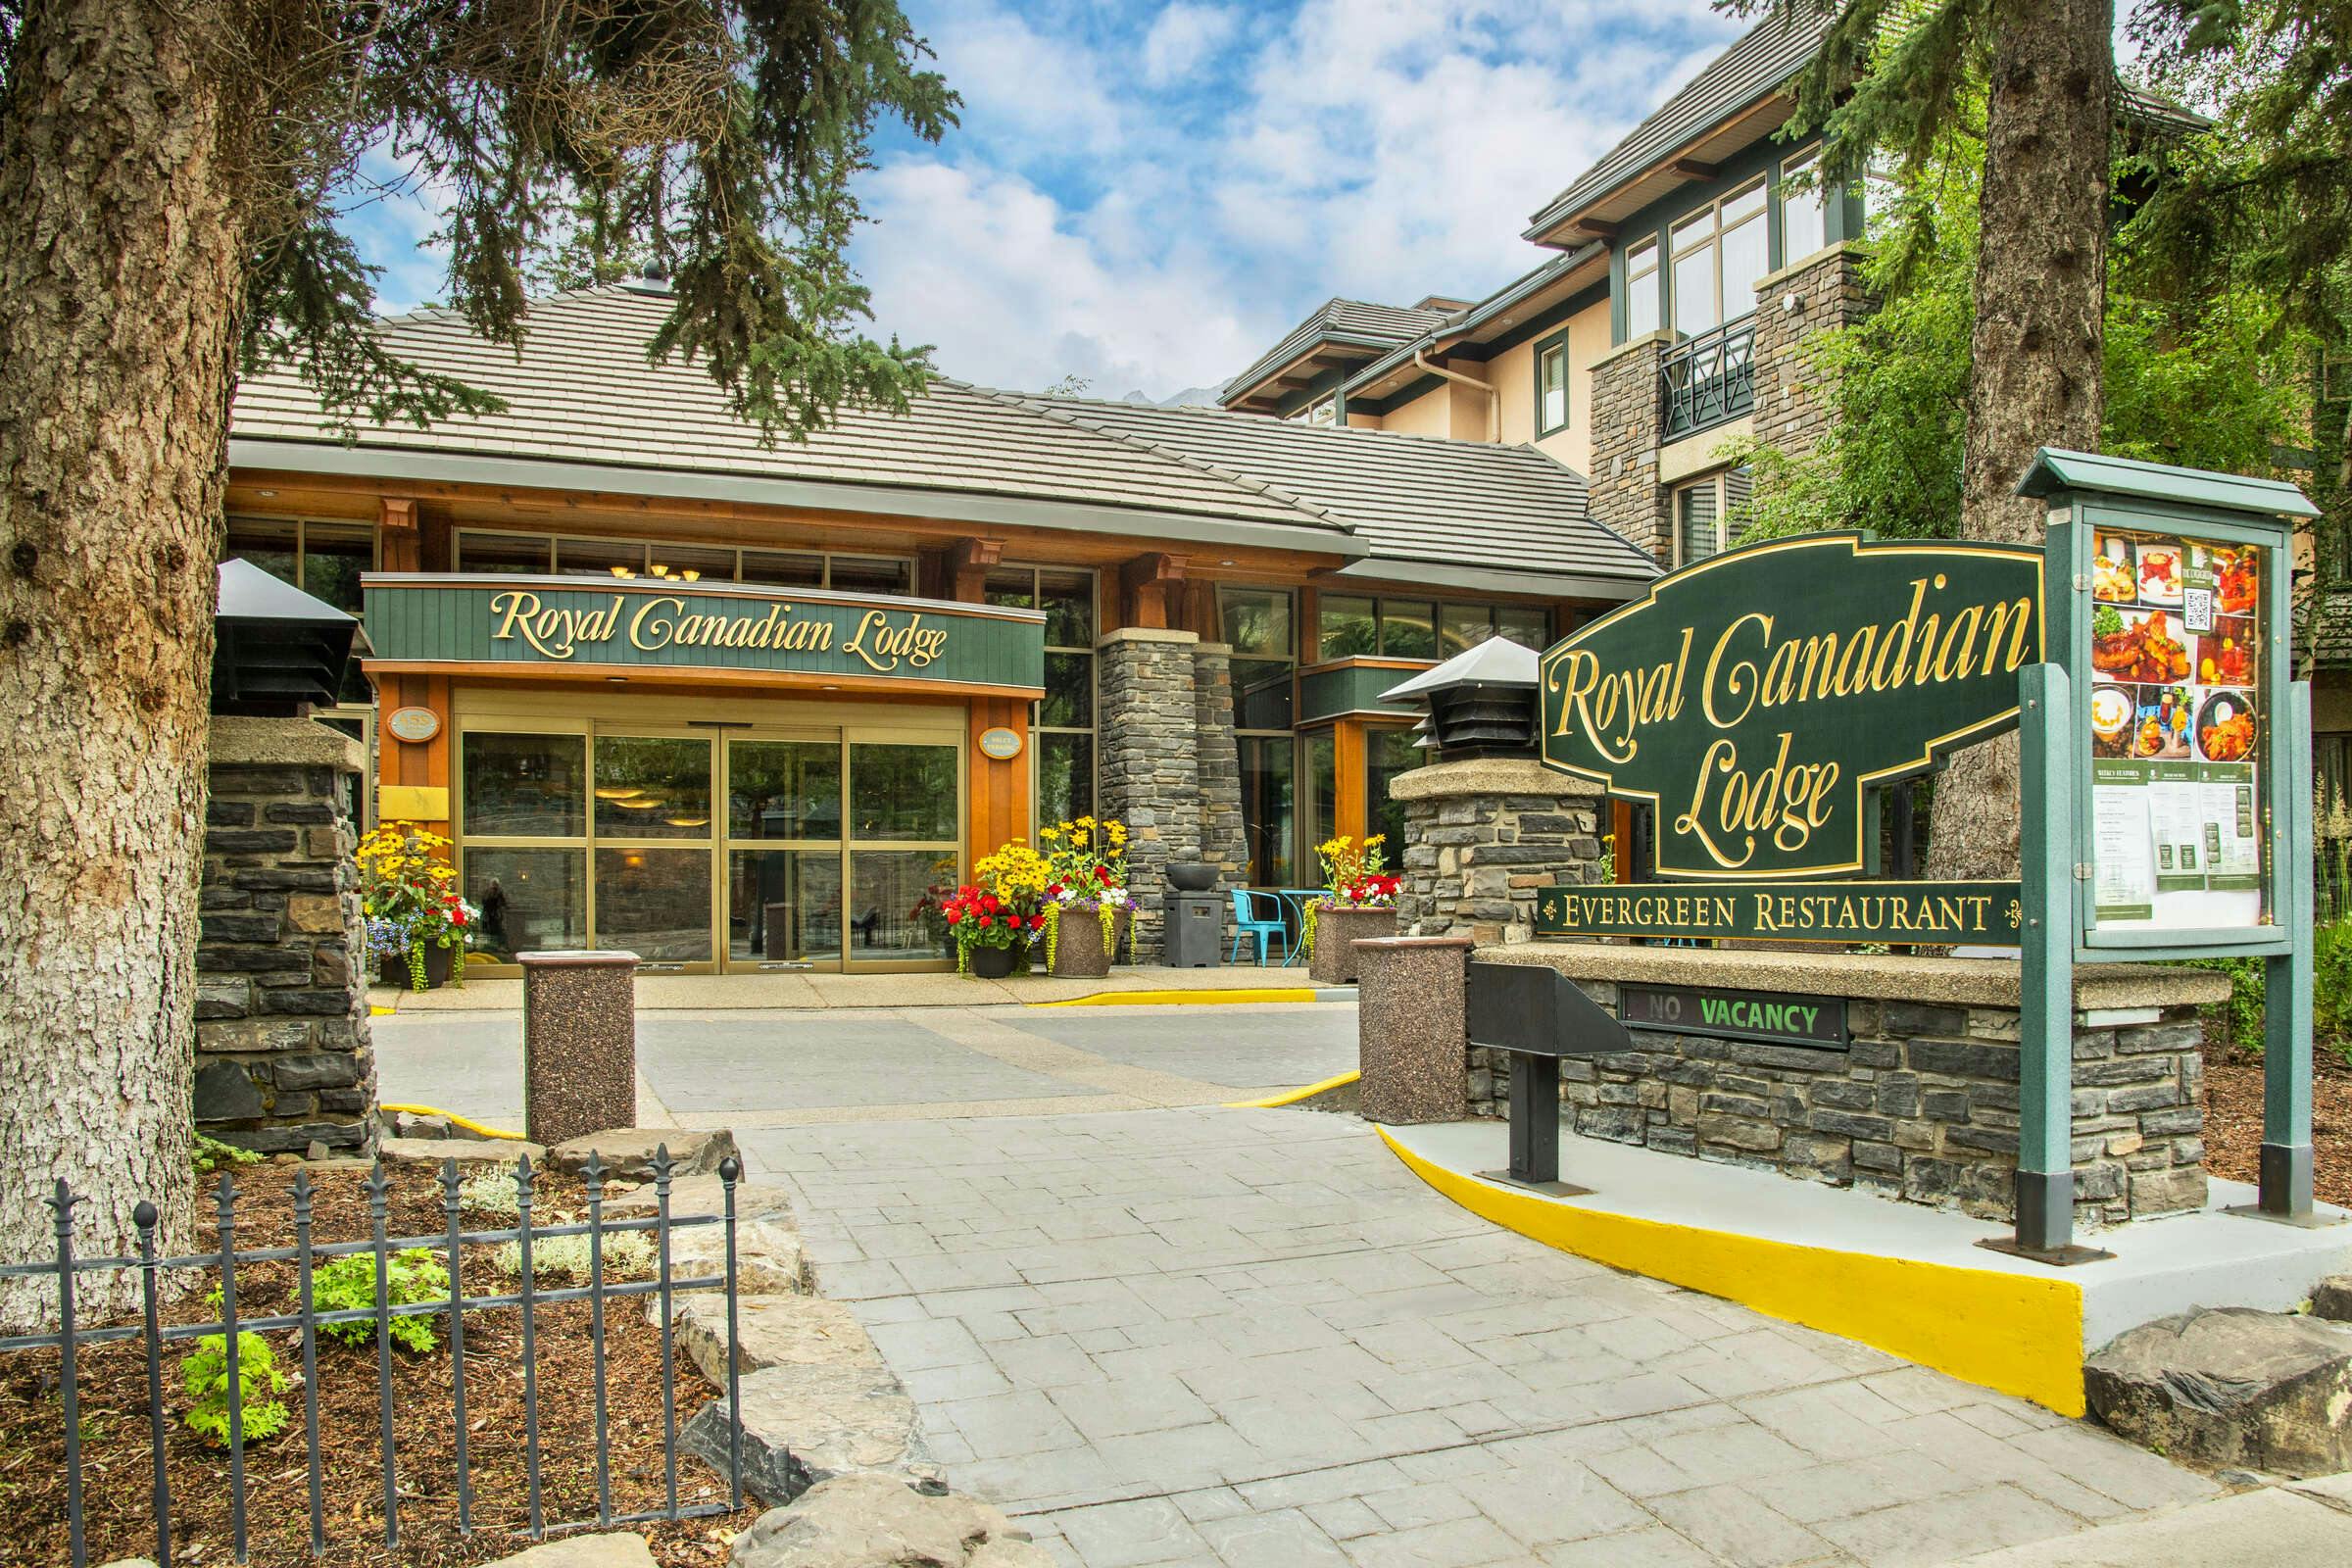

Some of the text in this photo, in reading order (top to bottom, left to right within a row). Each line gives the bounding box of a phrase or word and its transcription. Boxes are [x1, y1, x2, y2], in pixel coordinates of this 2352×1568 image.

[490, 591, 948, 672] Royal Canadian Lodge
[1547, 573, 2032, 765] Royal Canadian
[1674, 732, 1840, 869] Lodge
[1562, 893, 1992, 932] EVERGREEN RESTAURANT
[1648, 994, 1820, 1035] NO VACANCY
